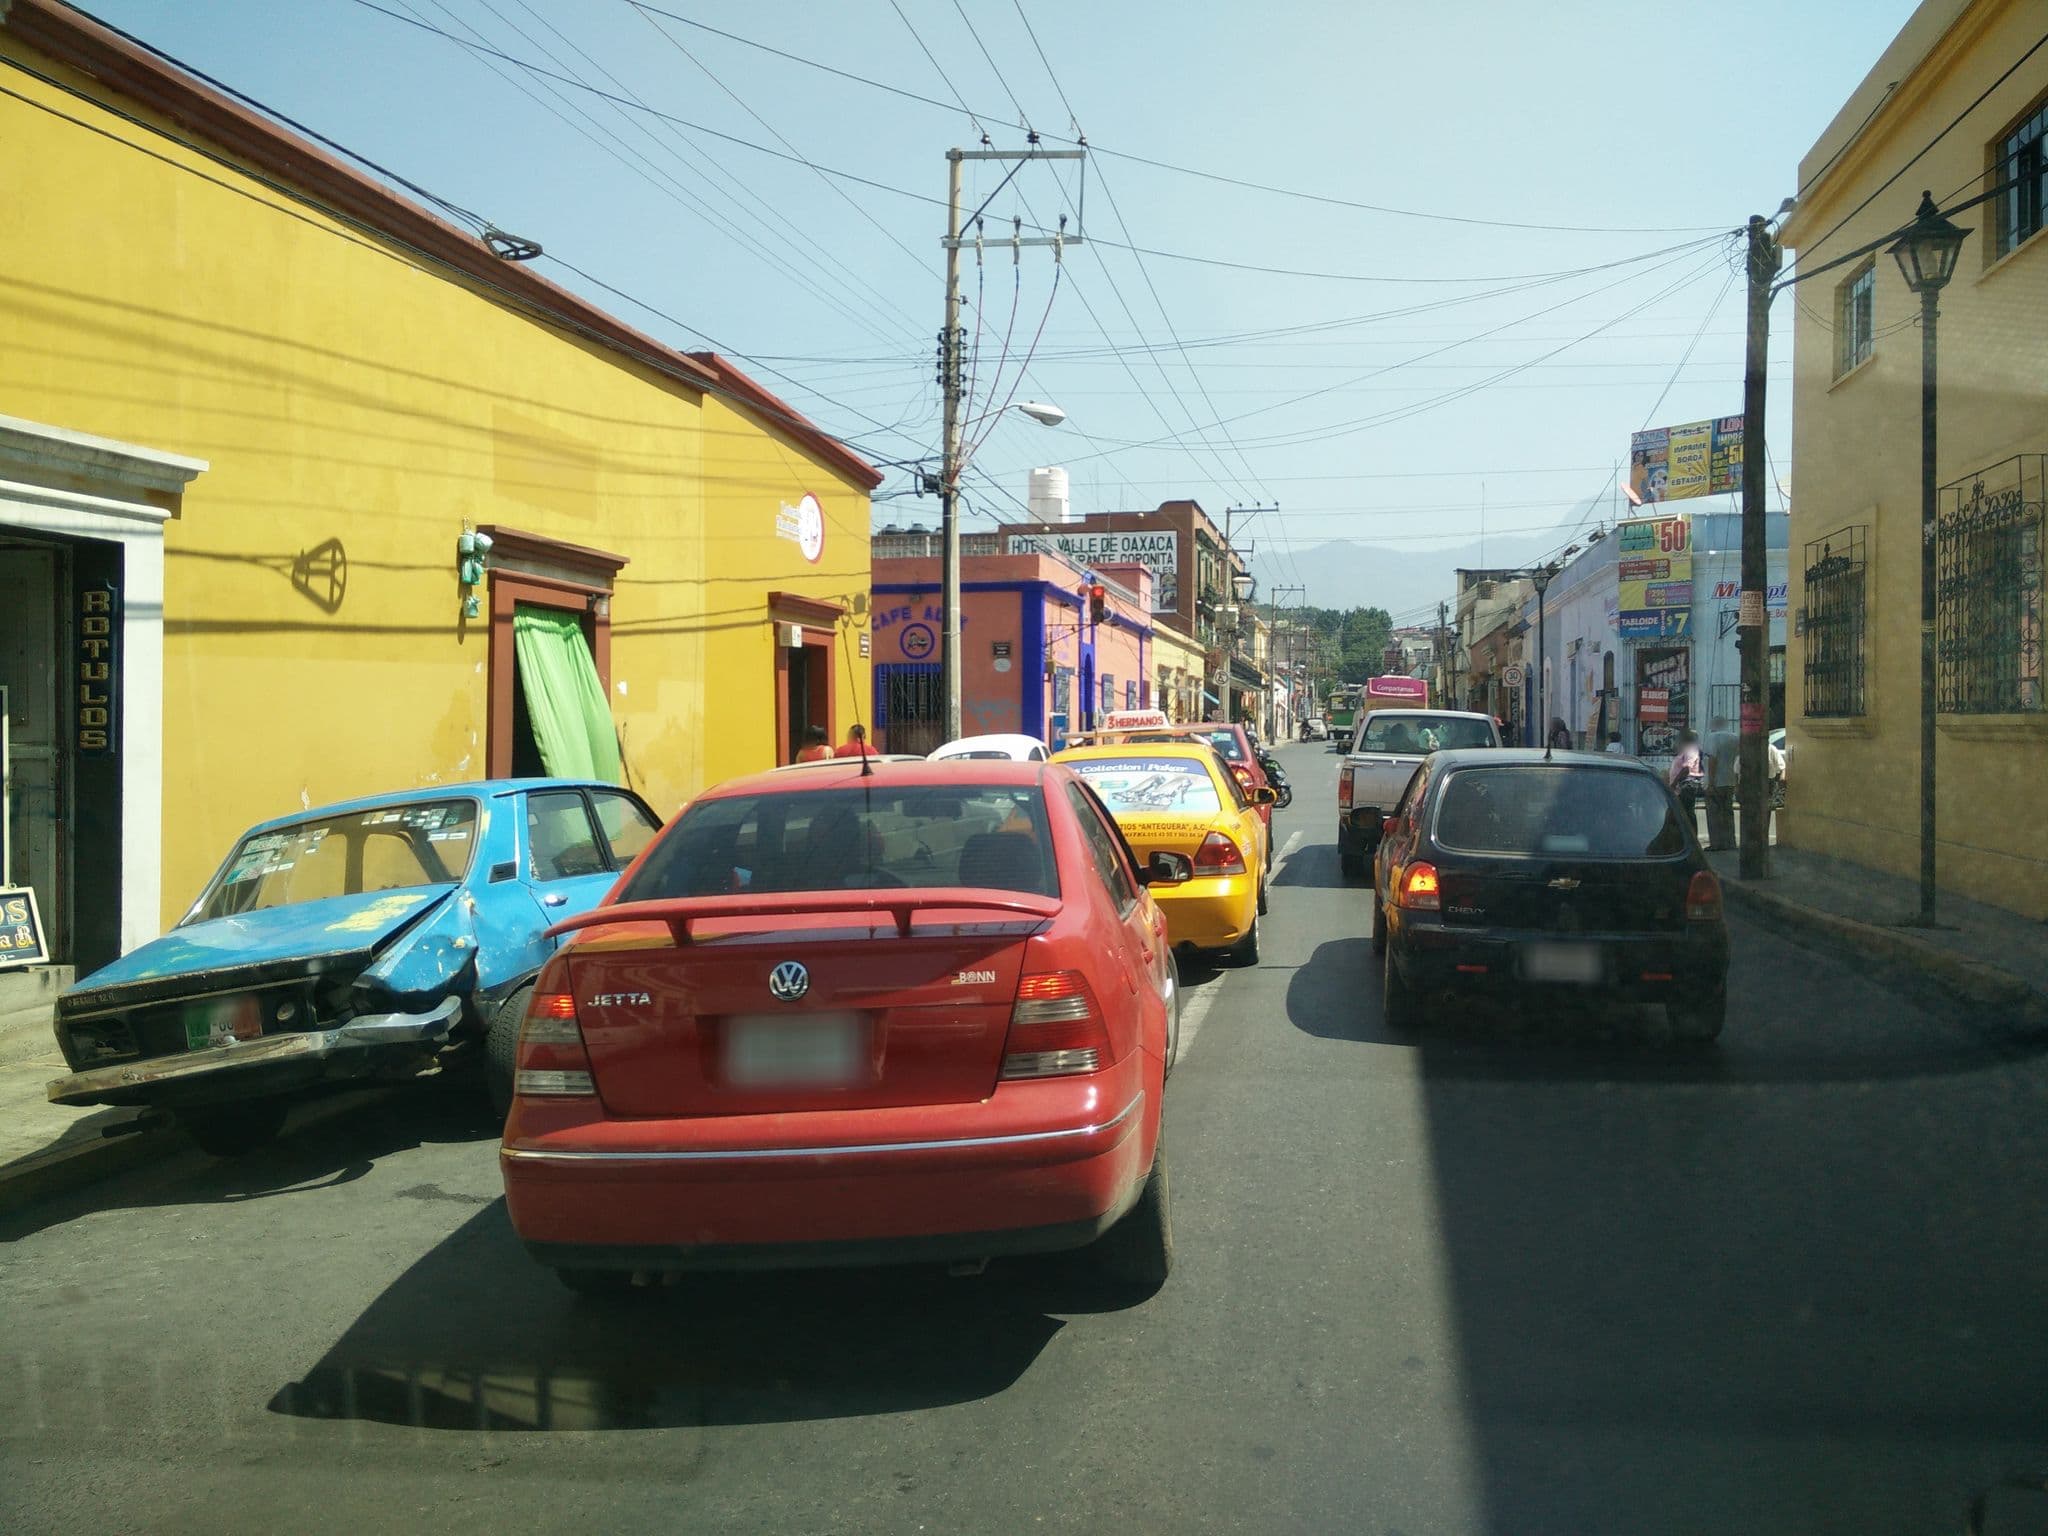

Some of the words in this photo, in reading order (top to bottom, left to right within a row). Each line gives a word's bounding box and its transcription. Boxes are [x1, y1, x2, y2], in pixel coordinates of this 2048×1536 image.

[1674, 443, 1707, 453] IMPRIME
[1677, 455, 1704, 464] BORDA
[1671, 476, 1707, 486] ESTAMPA
[1057, 537, 1097, 553] VALLE
[1101, 537, 1118, 552] DE
[1122, 536, 1174, 551] OAXACA
[871, 606, 912, 632] CAFE
[1620, 616, 1659, 627] TABLOIDE
[80, 590, 110, 749] ROTULOS
[1108, 717, 1116, 729] 3
[1116, 716, 1164, 727] HERMANOS
[1082, 763, 1141, 773] Collection
[587, 992, 652, 1007] JETTA
